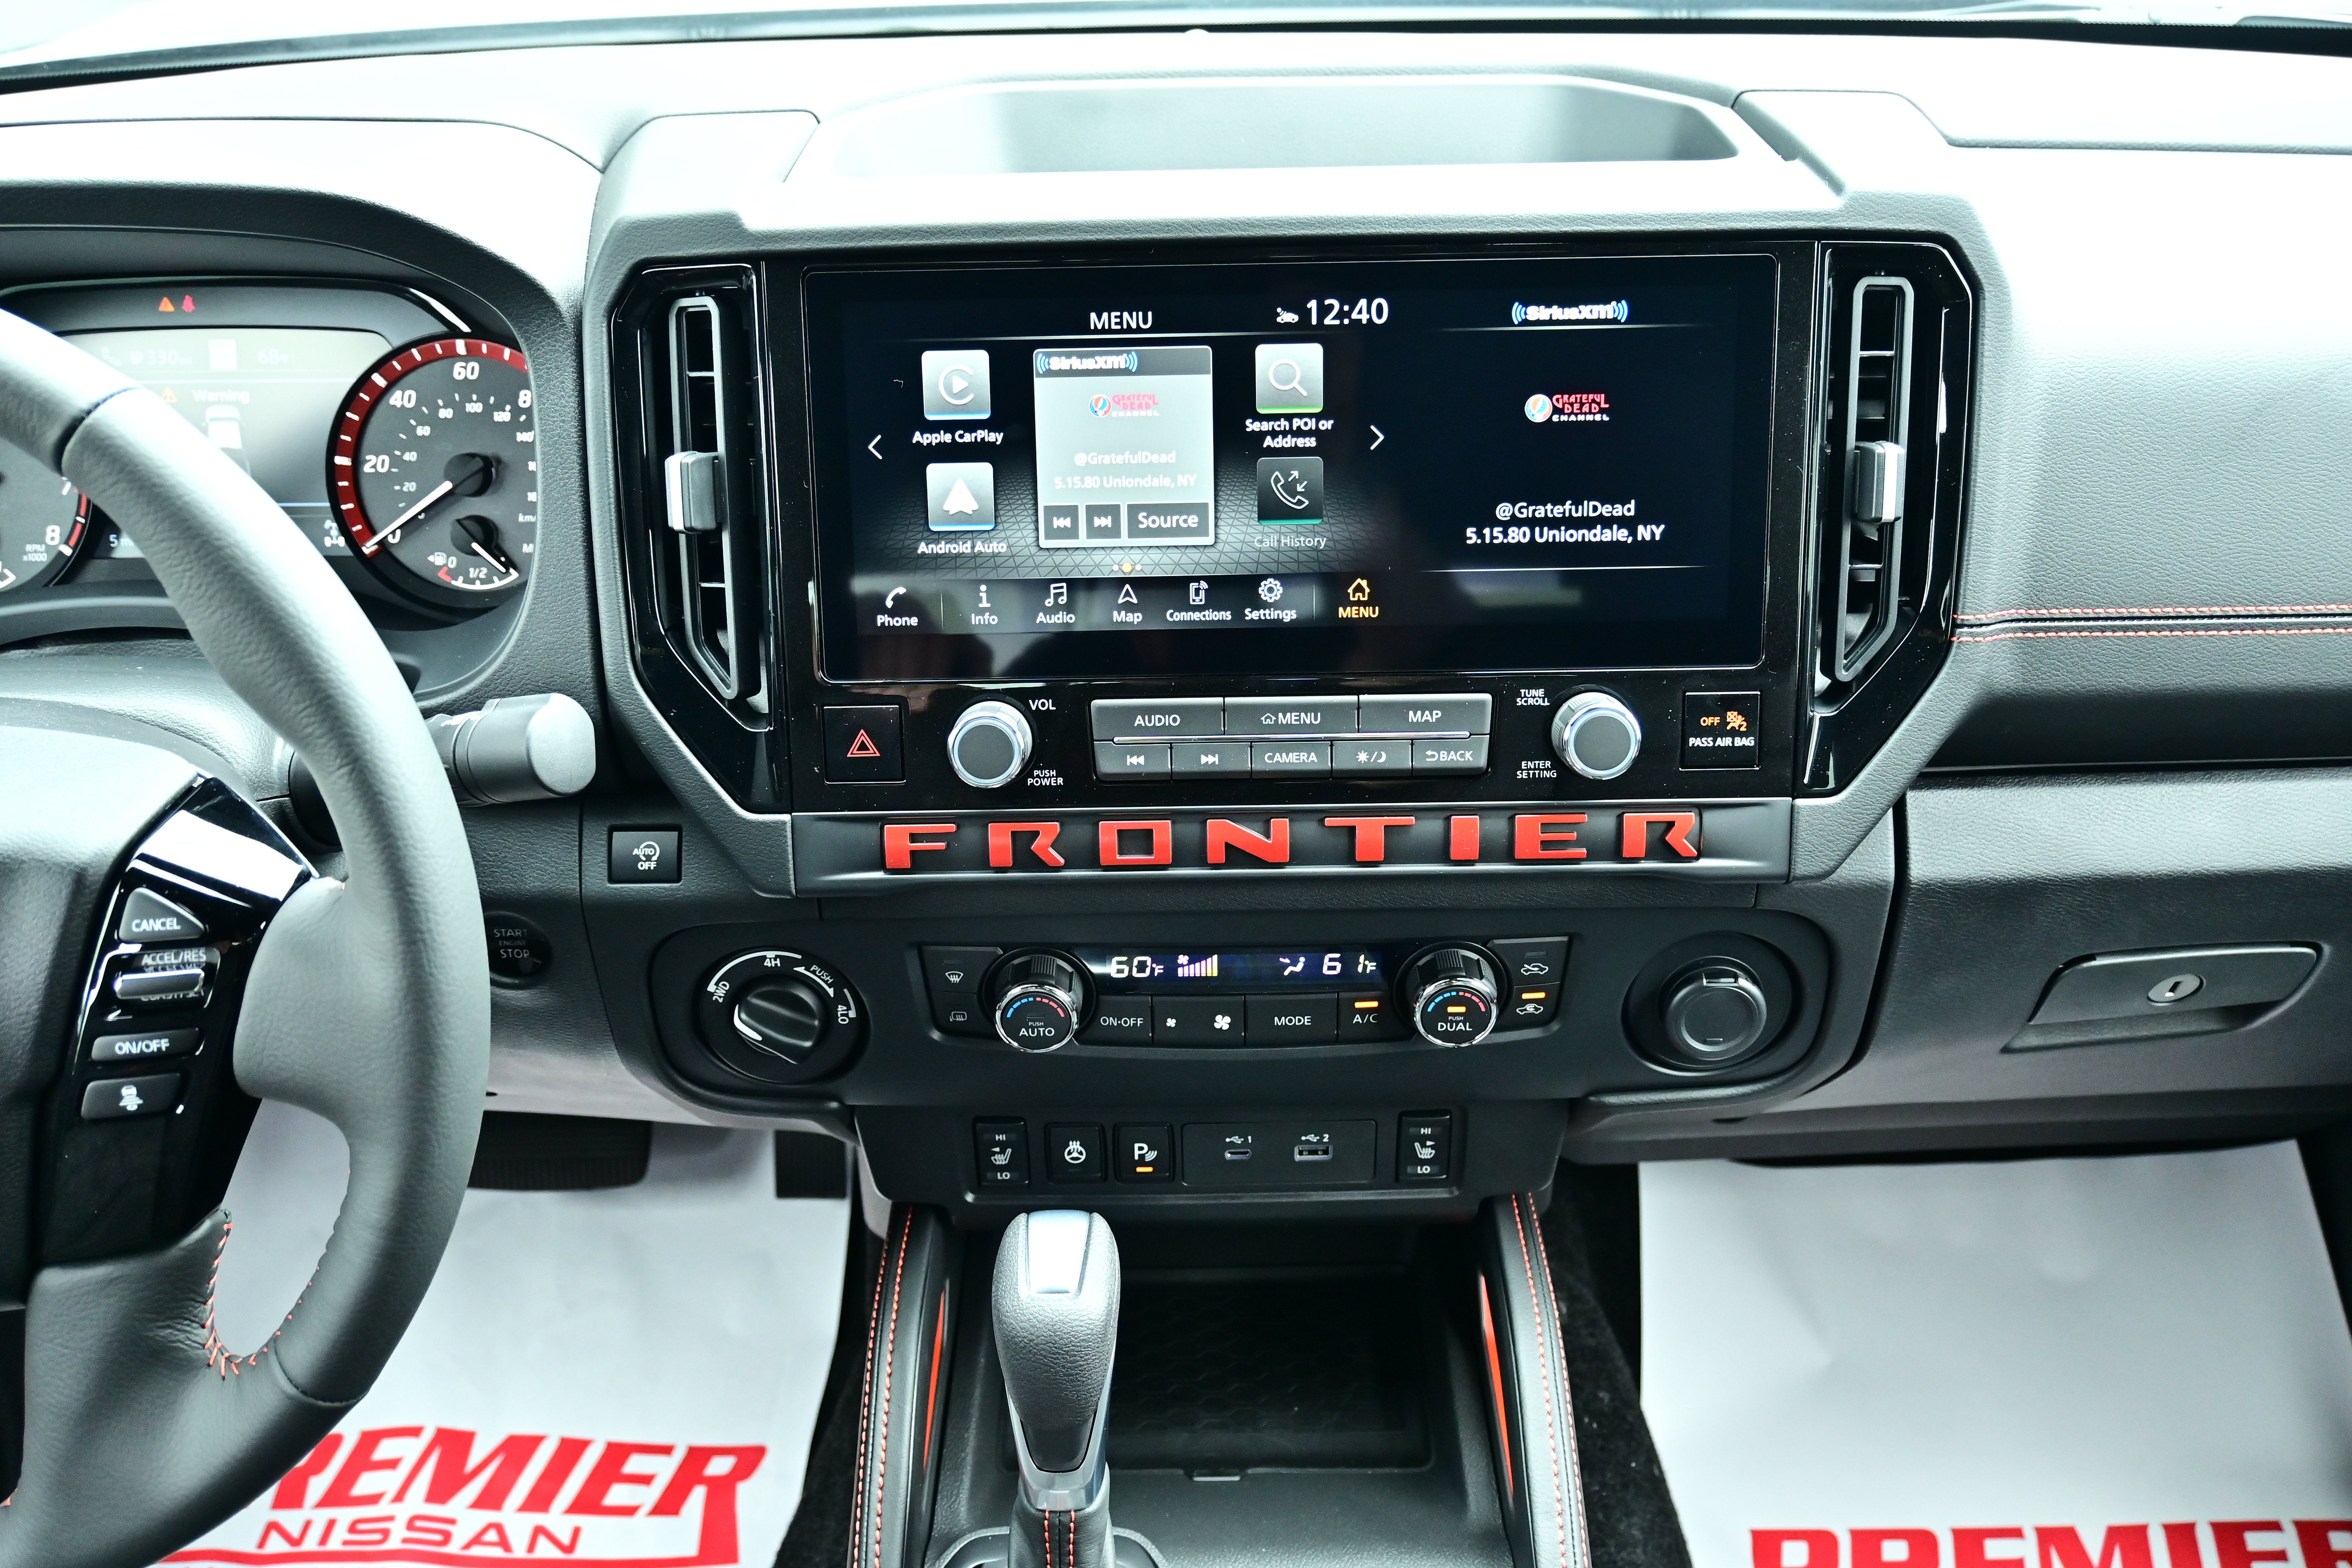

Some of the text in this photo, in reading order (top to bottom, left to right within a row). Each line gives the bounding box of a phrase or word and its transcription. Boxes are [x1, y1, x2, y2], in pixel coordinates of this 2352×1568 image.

[1306, 298, 1388, 325] 12:40
[1526, 305, 1613, 321] SiriusXM
[1090, 312, 1152, 329] MENU
[1049, 356, 1126, 370] SiriusXM
[453, 362, 479, 380] 60
[191, 389, 250, 404] Warning
[389, 390, 416, 408] 40
[518, 390, 531, 408] 8
[1552, 394, 1609, 408] GRATEFUL
[466, 403, 483, 413] 100
[1122, 402, 1151, 410] DEAD
[1564, 403, 1599, 413] DEAD
[438, 408, 453, 418] 80
[493, 411, 511, 422] 120
[1552, 414, 1609, 422] CHANNEL
[1245, 418, 1334, 431] Search POI or
[416, 426, 430, 436] 60
[912, 430, 1004, 446] Apple CarPlay
[1263, 435, 1316, 447] Address
[403, 452, 417, 462] 40
[1074, 450, 1176, 466] @GratefulDead
[364, 455, 389, 473] 20
[403, 482, 416, 492] 20
[1054, 475, 1197, 489] 5.15.80 Uniondale, NY
[1495, 499, 1635, 520] @GratefulDead
[1138, 512, 1199, 528] Source
[45, 525, 60, 544] 8
[1465, 524, 1665, 544] 5.15.80 Uniondale, NY
[109, 534, 118, 547] 5
[1254, 536, 1326, 549] Call History
[26, 544, 46, 553] RPM
[917, 541, 1007, 554] Android Auto
[23, 553, 47, 562] x1000
[448, 557, 457, 568] 0
[468, 567, 488, 578] 1/2
[1036, 612, 1075, 624] Audio
[1113, 610, 1143, 623] Map
[1166, 610, 1232, 621] Connections
[1244, 608, 1297, 622] Settings
[1338, 606, 1379, 618] MENU
[877, 614, 918, 627] Phone
[971, 612, 998, 625] Info
[1520, 689, 1544, 697] TUNE
[1029, 699, 1056, 711] VOL
[1516, 697, 1550, 706] SCROLL
[1134, 714, 1181, 727] AUDIO
[1278, 713, 1321, 725] MENU
[1408, 710, 1442, 723] MAP
[1700, 717, 1720, 726] OFF
[1689, 737, 1755, 747] PASS AIR BAG
[1265, 753, 1318, 764] CAMERA
[1440, 751, 1473, 762] BACK
[1522, 760, 1551, 769] ENTER
[1034, 769, 1056, 778] PUSH
[1516, 769, 1557, 779] SETTING
[1027, 777, 1064, 786] POWER
[884, 812, 1698, 868] FRONTIER
[633, 848, 655, 856] AUTO
[637, 862, 657, 870] OFF
[131, 917, 181, 931] CANCEL
[493, 928, 528, 938] START
[142, 947, 206, 965] ACCEL/RES
[500, 949, 530, 958] STOP
[764, 958, 781, 968] 4H
[811, 965, 834, 984] PUSH
[712, 981, 730, 1003] 2WD
[836, 1004, 849, 1025] 4LO
[1274, 1015, 1312, 1026] MODE
[1352, 1013, 1378, 1024] A/C
[1018, 1027, 1055, 1037] AUTO
[1437, 1021, 1473, 1032] DUAL
[114, 1038, 170, 1054] ON/OFF
[1323, 1134, 1329, 1142] 2
[1417, 1165, 1431, 1173] LO
[997, 1172, 1010, 1180] LO
[257, 1514, 582, 1555] NISSAN
